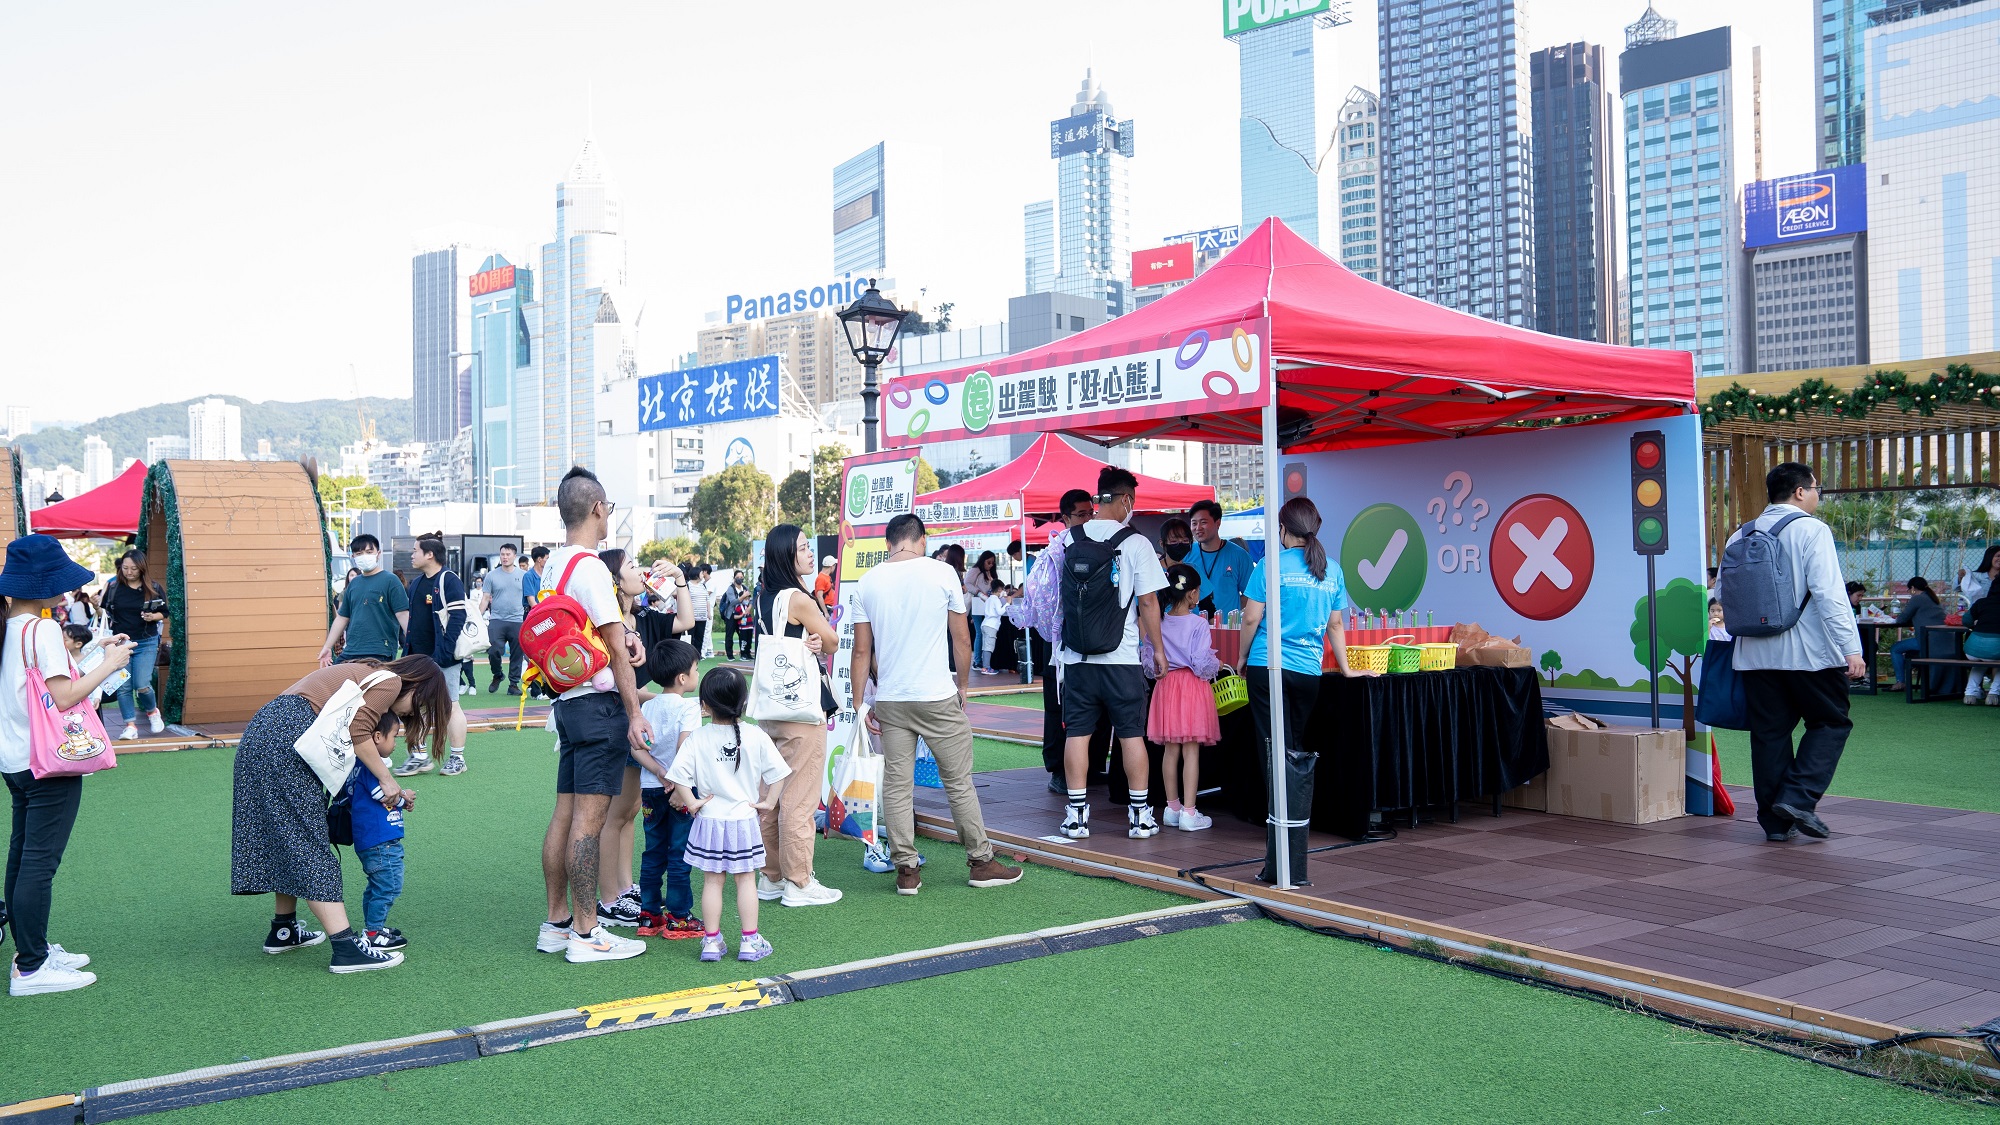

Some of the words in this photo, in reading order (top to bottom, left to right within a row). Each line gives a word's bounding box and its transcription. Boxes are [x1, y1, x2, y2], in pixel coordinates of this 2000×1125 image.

[1782, 224, 1803, 232] CREDIT
[1805, 220, 1829, 229] SERVICE
[470, 266, 513, 296] 30周年
[727, 272, 868, 324] Panasonic
[641, 363, 777, 425] 北京控股
[1437, 544, 1481, 574] OR
[532, 617, 555, 635] MARVEL
